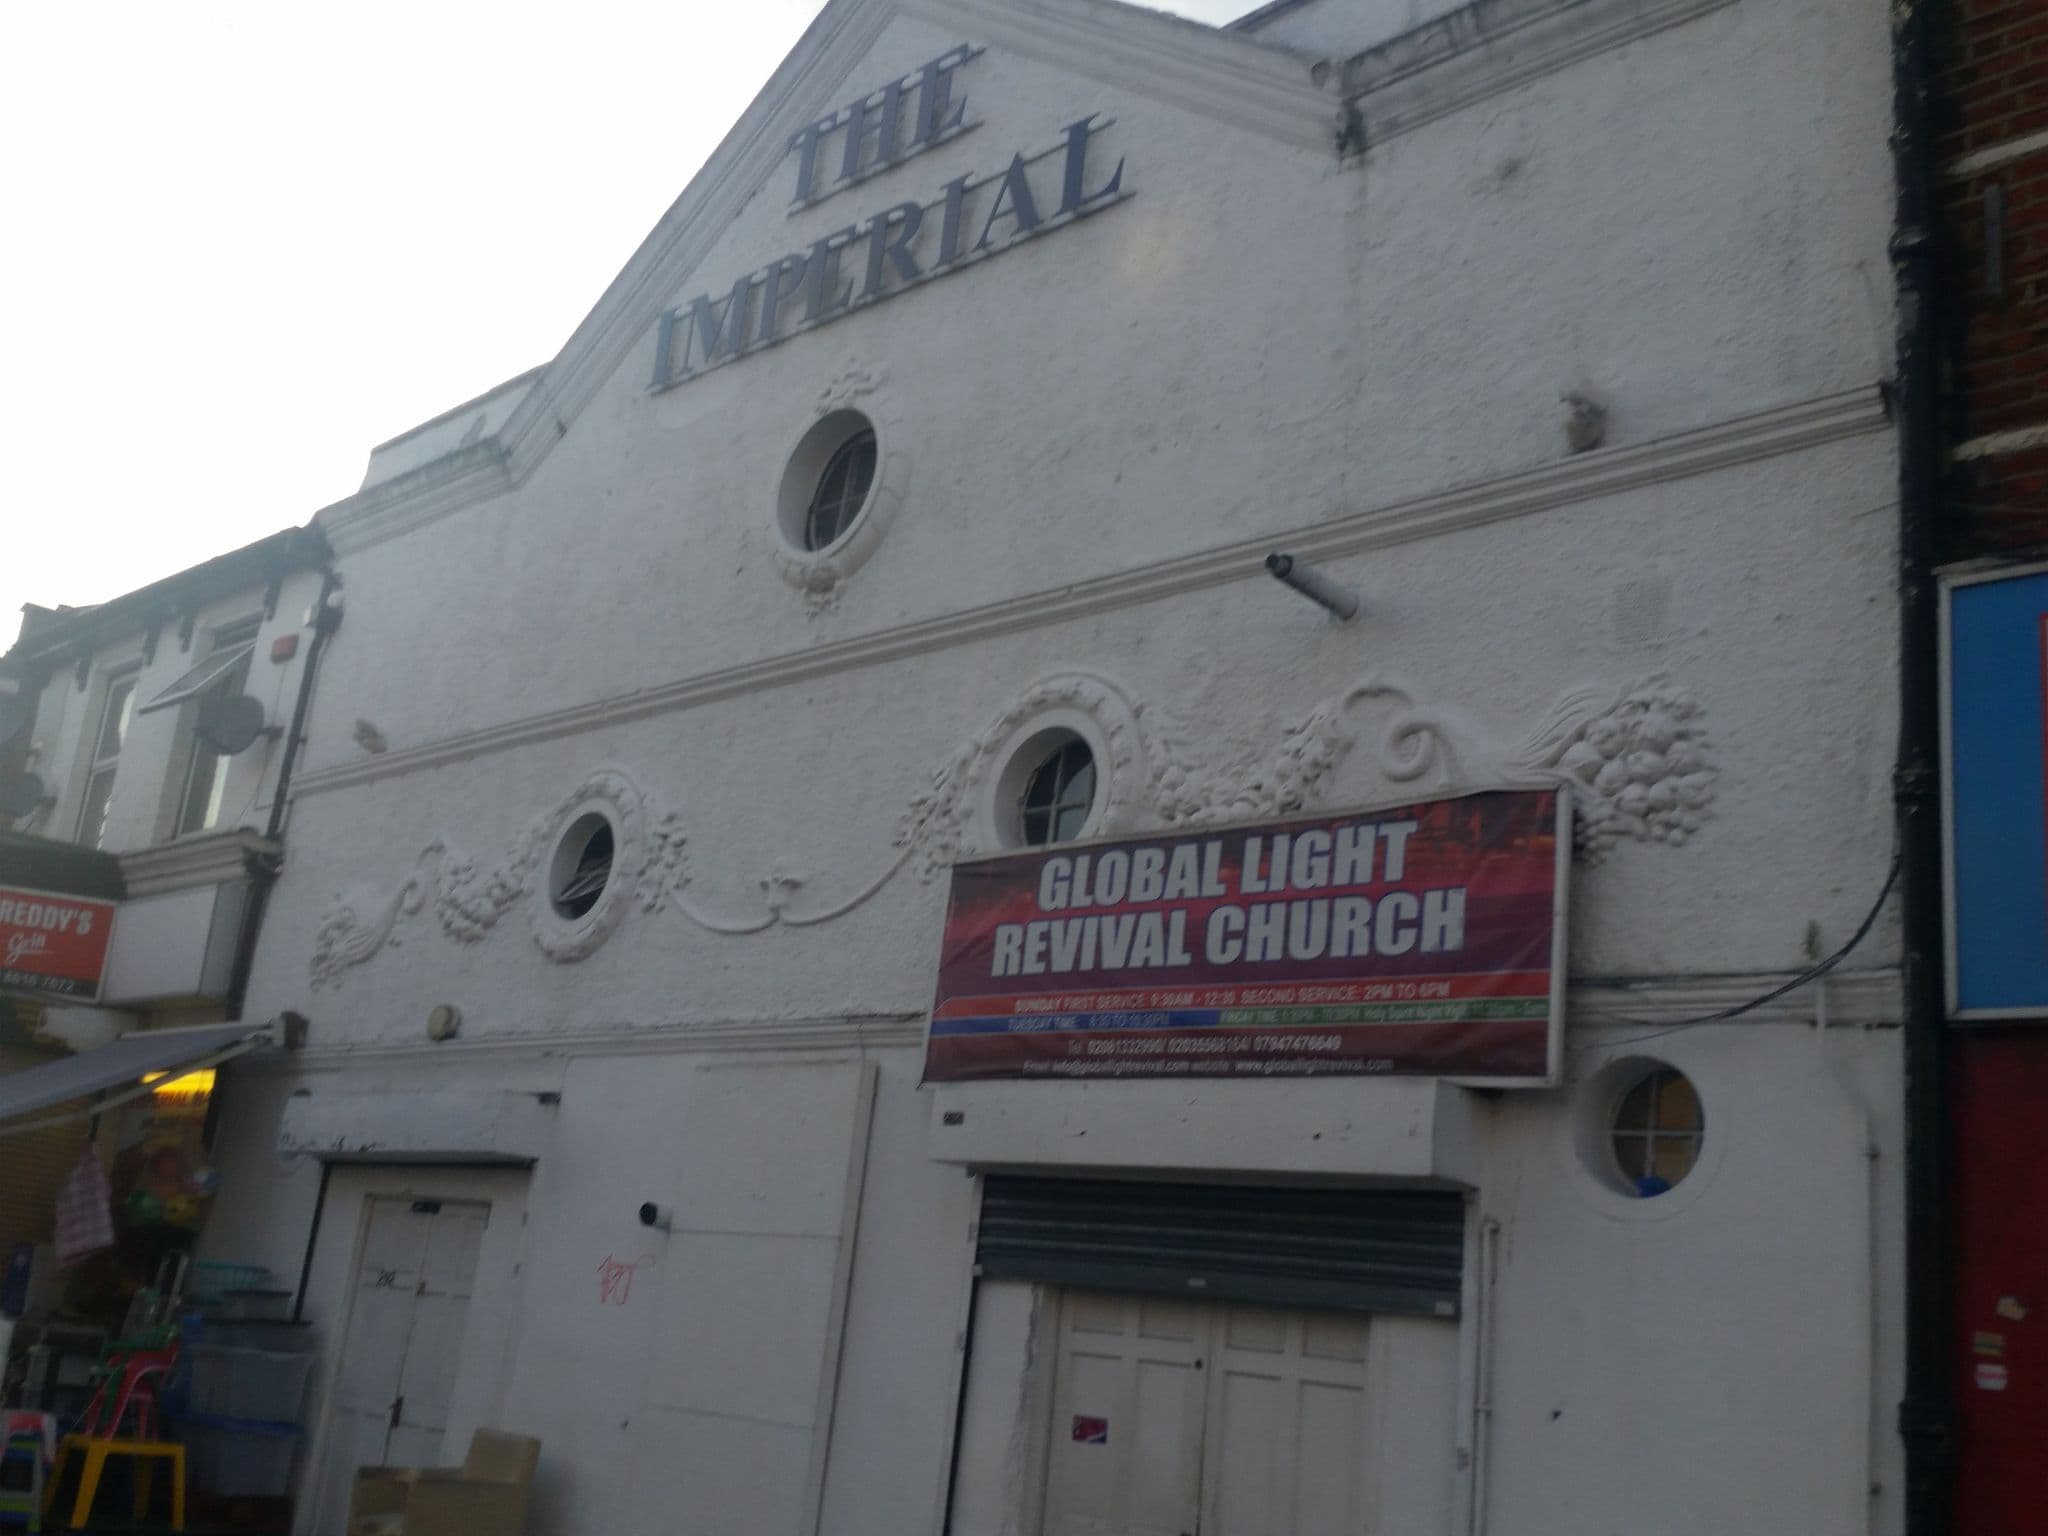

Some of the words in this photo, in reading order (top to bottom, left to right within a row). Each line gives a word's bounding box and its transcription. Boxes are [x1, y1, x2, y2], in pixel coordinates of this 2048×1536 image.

[788, 42, 986, 218] THE
[647, 112, 1136, 394] IMPERIAL
[1038, 840, 1229, 913] GLOBAL
[1240, 819, 1419, 898] LIGHT
[990, 910, 1192, 977] REVIVAL
[1205, 887, 1467, 966] CHURCH
[1015, 997, 1062, 1013] SUNDAY
[1063, 995, 1096, 1010] FIRST
[1240, 988, 1299, 1004] SECOND
[1397, 982, 1417, 998] TO
